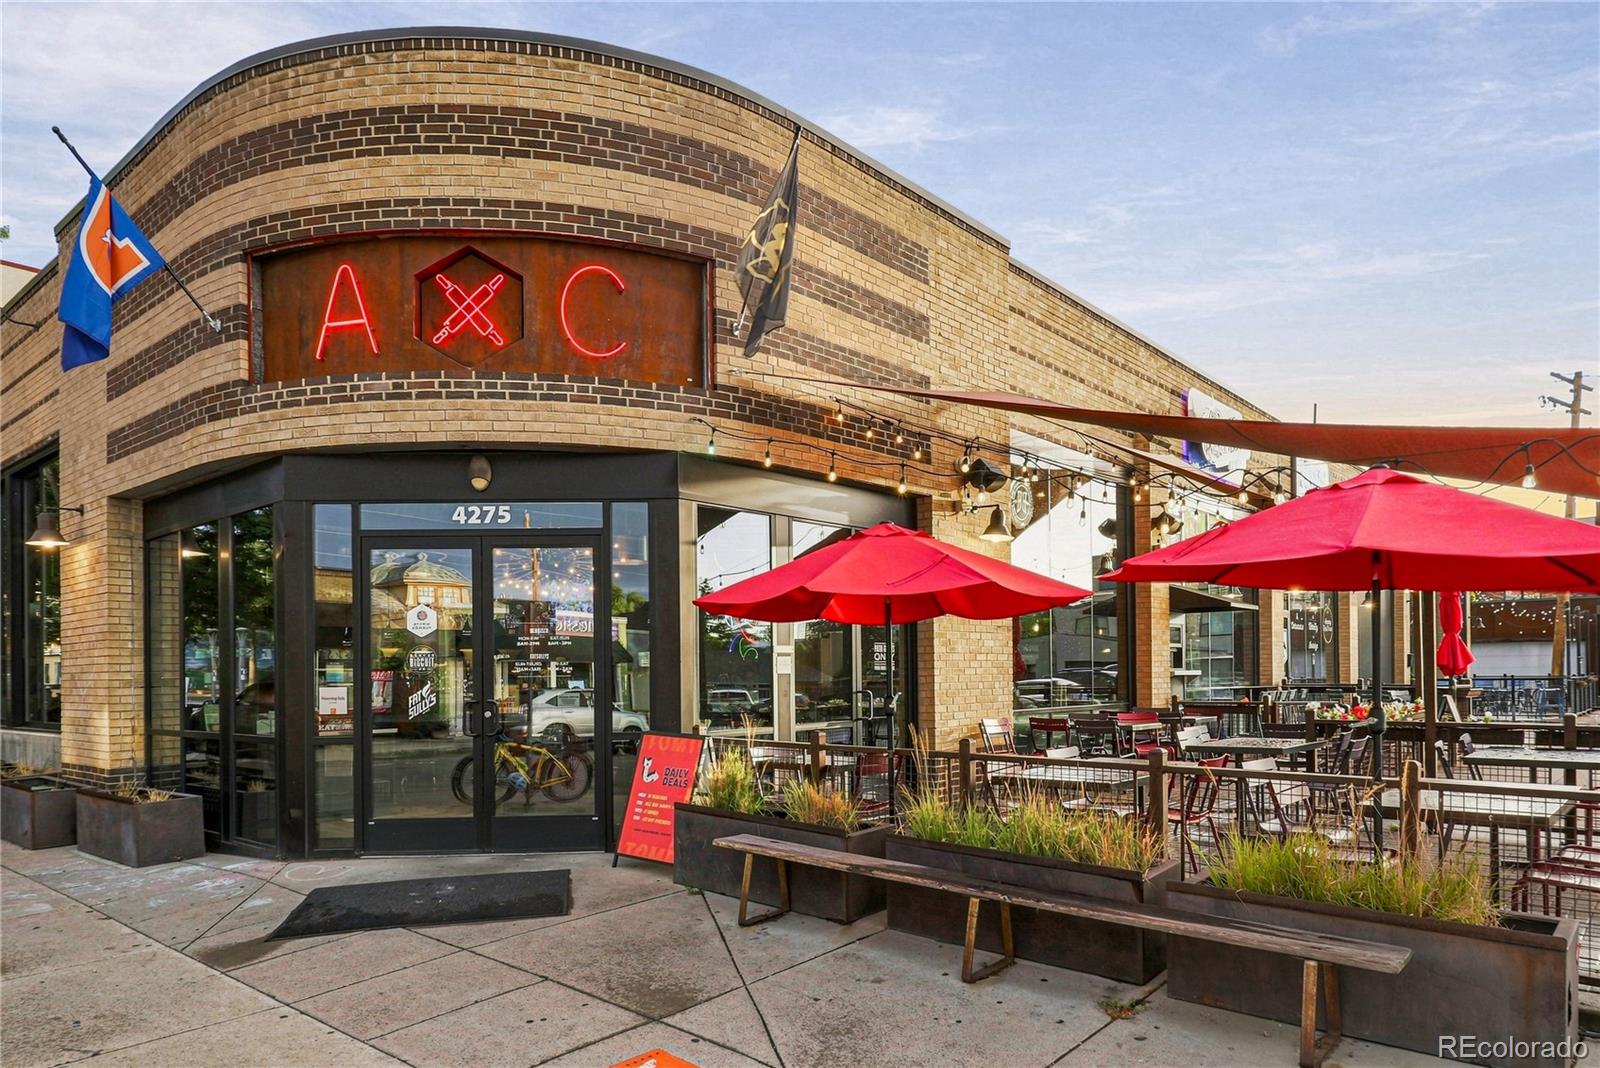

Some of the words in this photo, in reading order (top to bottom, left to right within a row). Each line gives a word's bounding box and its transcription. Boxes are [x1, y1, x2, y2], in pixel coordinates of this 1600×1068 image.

[315, 263, 381, 361] A
[560, 265, 627, 358] C
[451, 504, 512, 525] 4275
[408, 689, 422, 708] FAT
[664, 767, 689, 778] DAILY
[662, 777, 689, 788] DEALS
